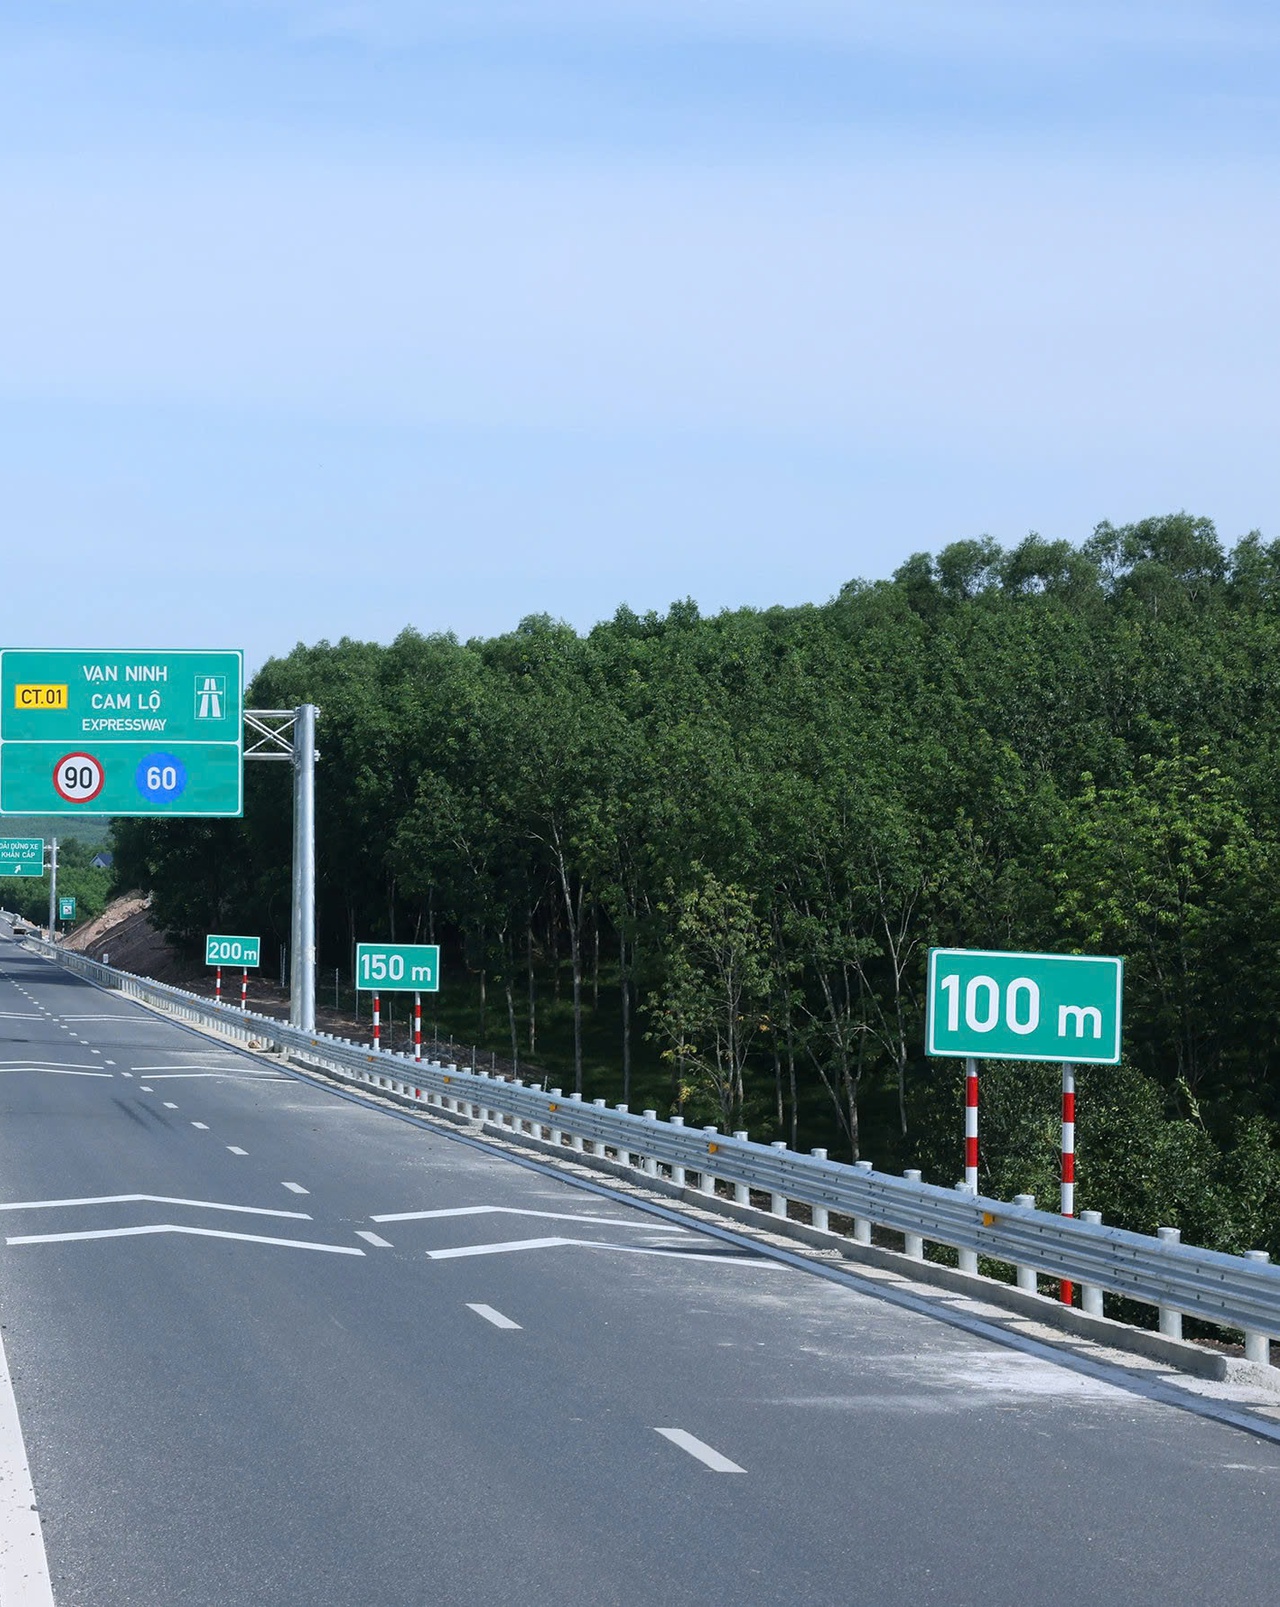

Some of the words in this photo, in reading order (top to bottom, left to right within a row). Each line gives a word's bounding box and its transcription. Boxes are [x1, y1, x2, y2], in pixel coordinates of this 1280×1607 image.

[83, 665, 118, 685] VẠN
[125, 665, 168, 682] NINH
[21, 689, 62, 704] CT.01
[91, 693, 131, 710] CAM
[138, 689, 161, 713] LỘ
[82, 718, 167, 731] EXPRESSWAY
[64, 766, 93, 789] 90
[146, 766, 177, 790] 60
[208, 942, 242, 960] 200
[244, 950, 258, 961] m
[361, 954, 404, 980] 150
[411, 965, 432, 982] m
[940, 974, 1041, 1035] 100
[1057, 1004, 1103, 1039] m
